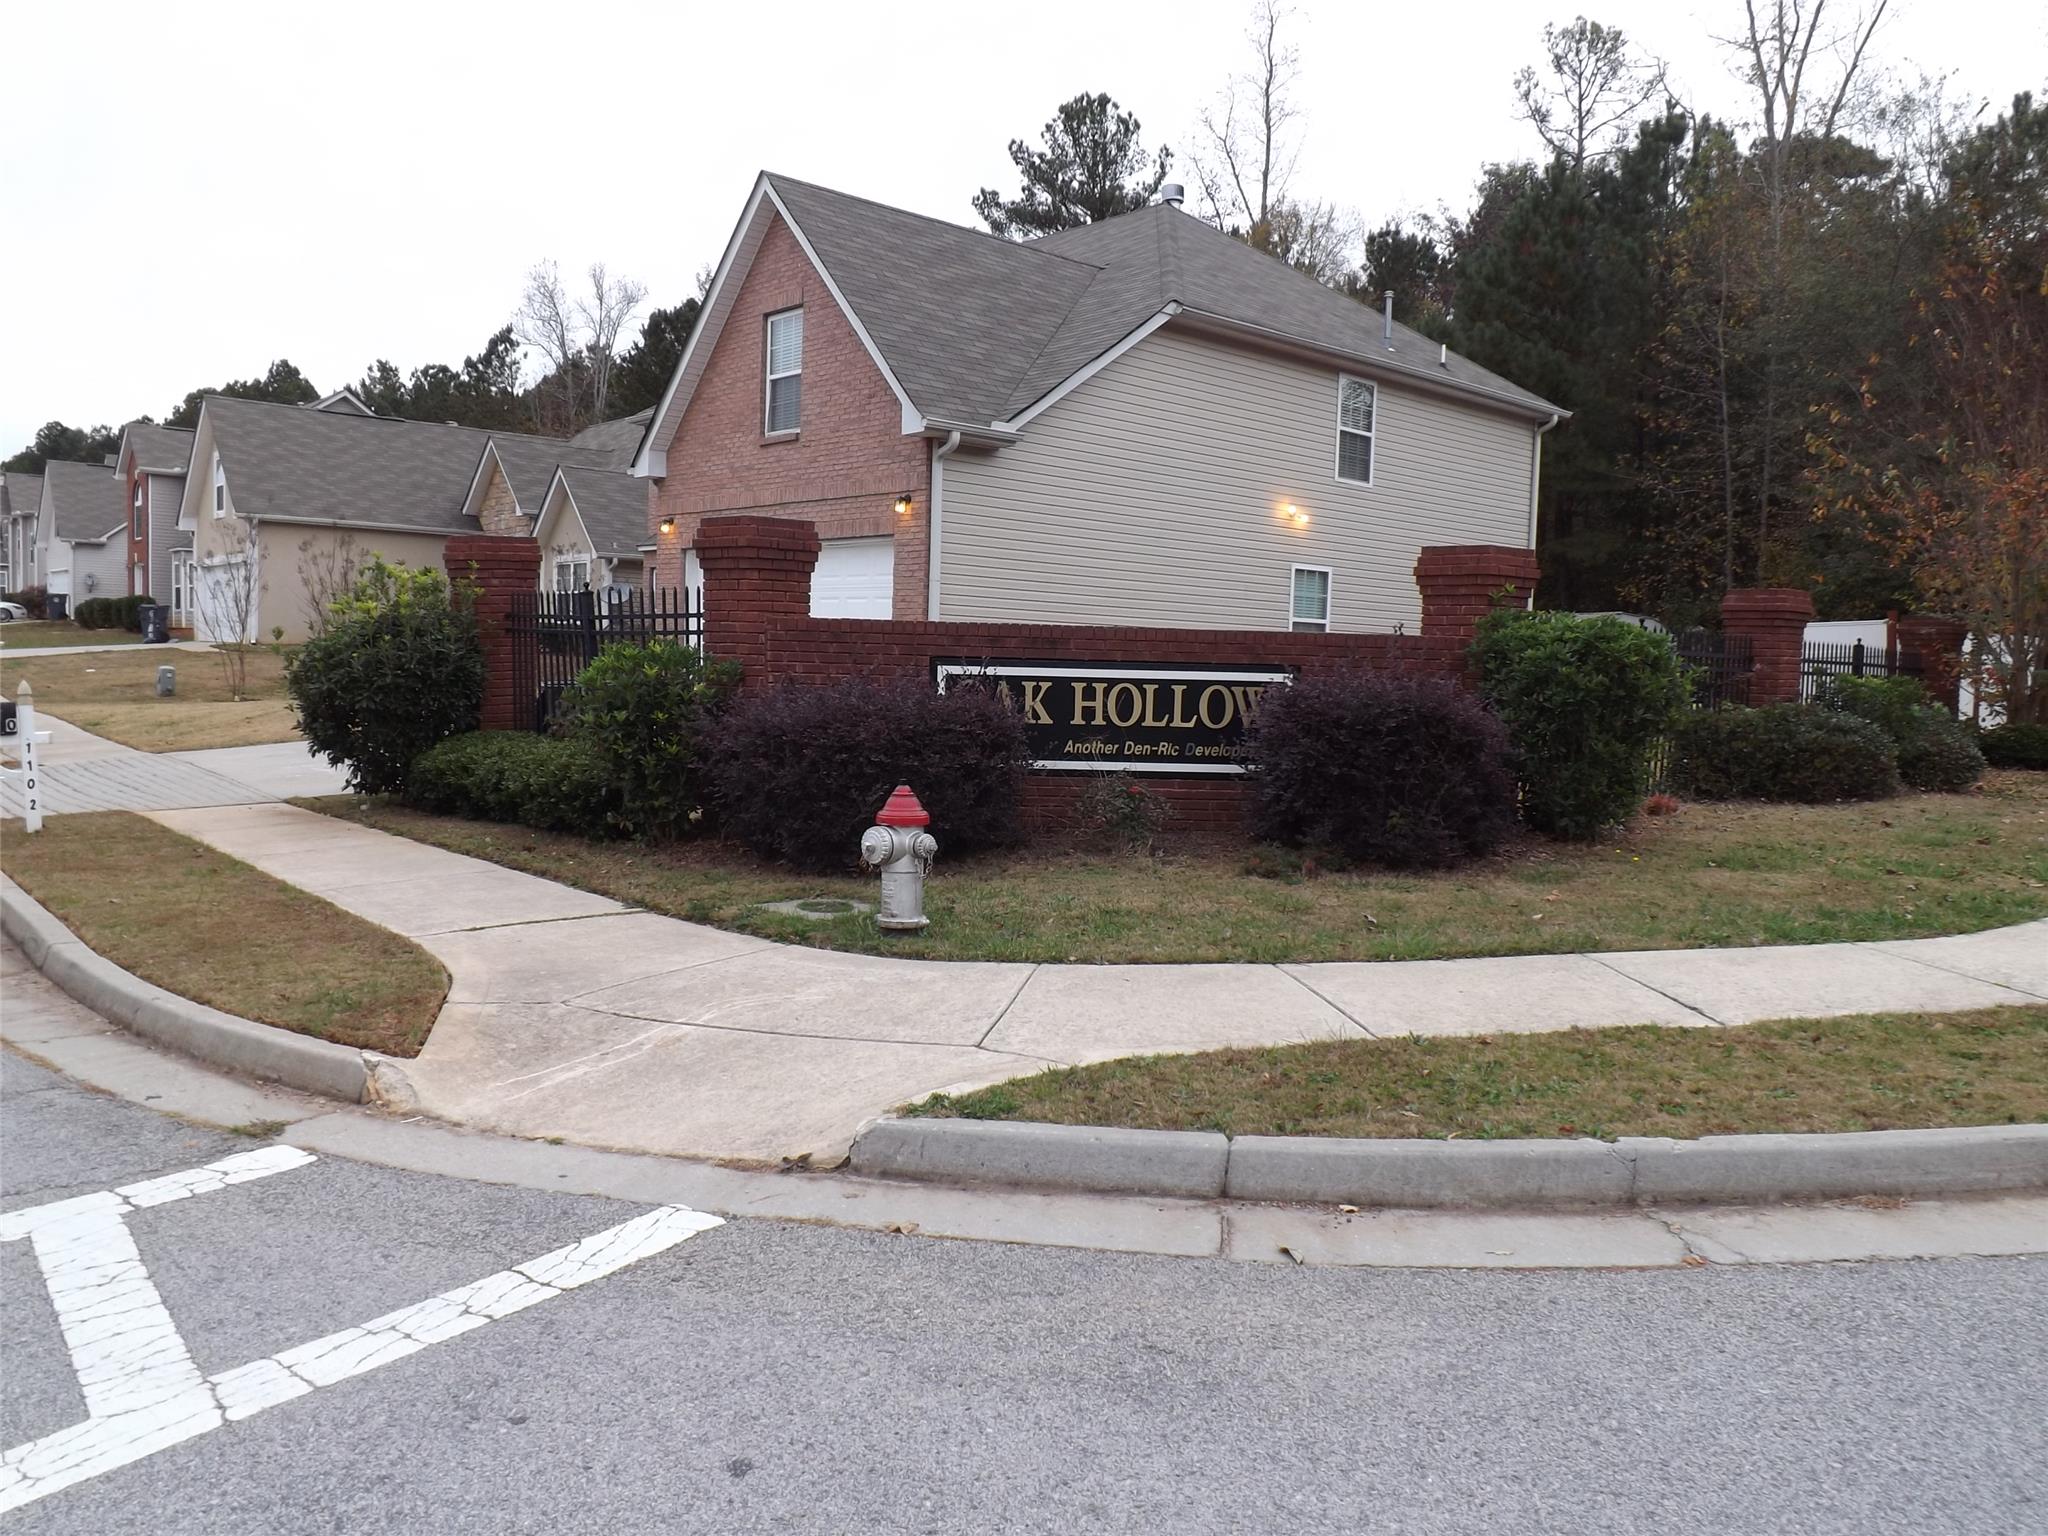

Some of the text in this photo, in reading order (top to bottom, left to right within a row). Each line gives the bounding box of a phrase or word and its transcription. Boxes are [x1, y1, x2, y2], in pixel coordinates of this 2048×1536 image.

[1070, 682, 1265, 729] HOLLOW
[1064, 740, 1249, 758] Another Den-Ric Develop
[26, 742, 36, 809] 1102
